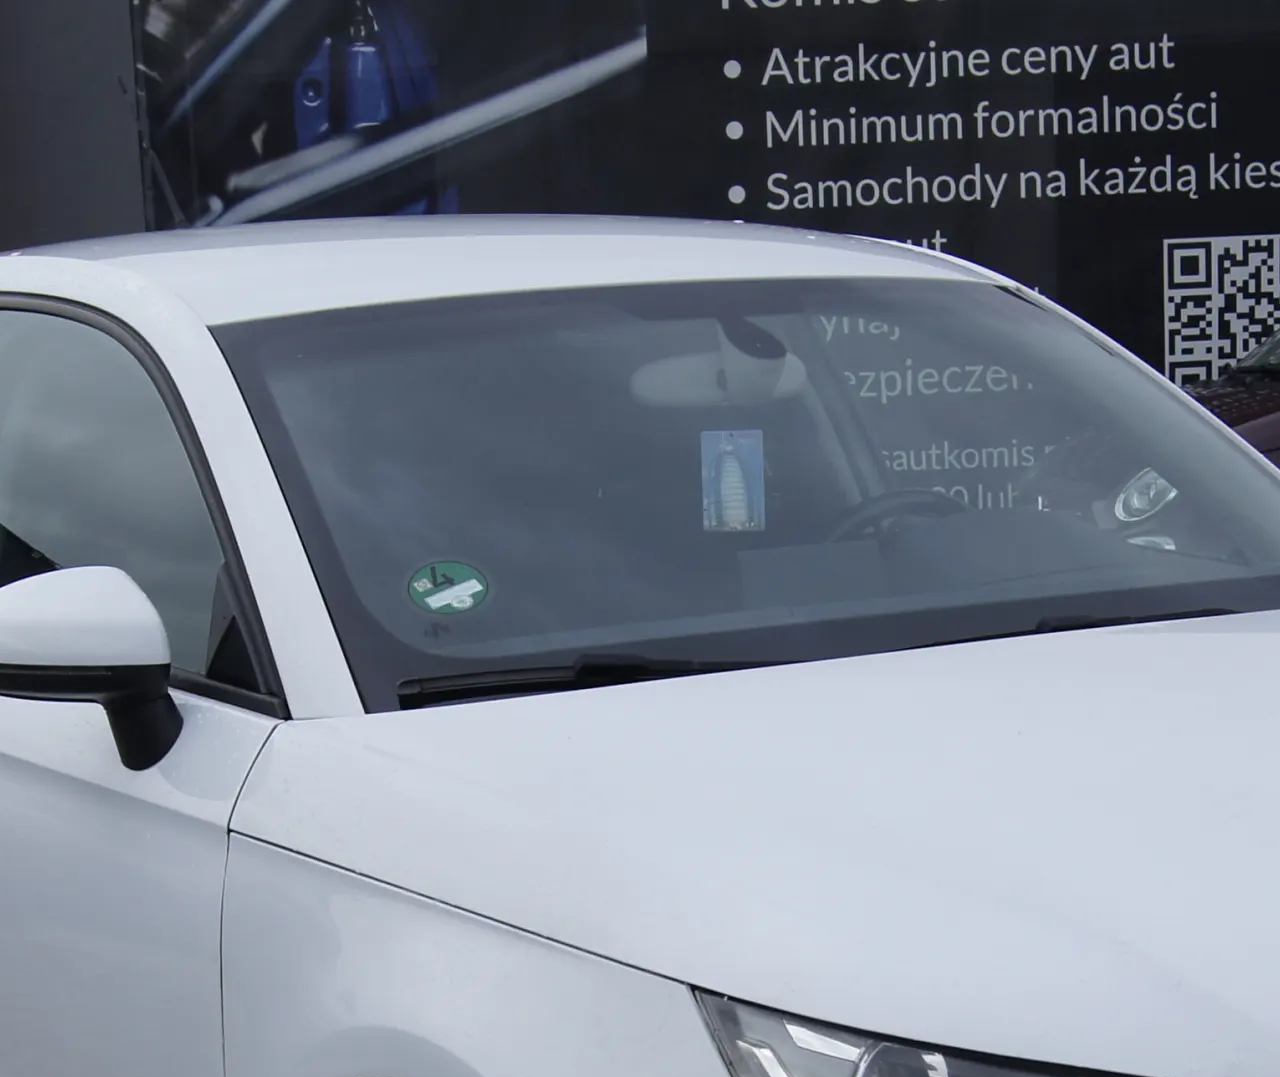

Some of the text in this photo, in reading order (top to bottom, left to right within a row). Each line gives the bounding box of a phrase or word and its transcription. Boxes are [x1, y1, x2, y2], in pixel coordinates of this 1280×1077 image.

[761, 33, 1175, 87] Atrakcyjne ceny aut
[766, 92, 1217, 148] Minimum formalności
[767, 163, 1008, 209] Samochody
[1020, 168, 1066, 198] na
[1080, 154, 1198, 199] każdą
